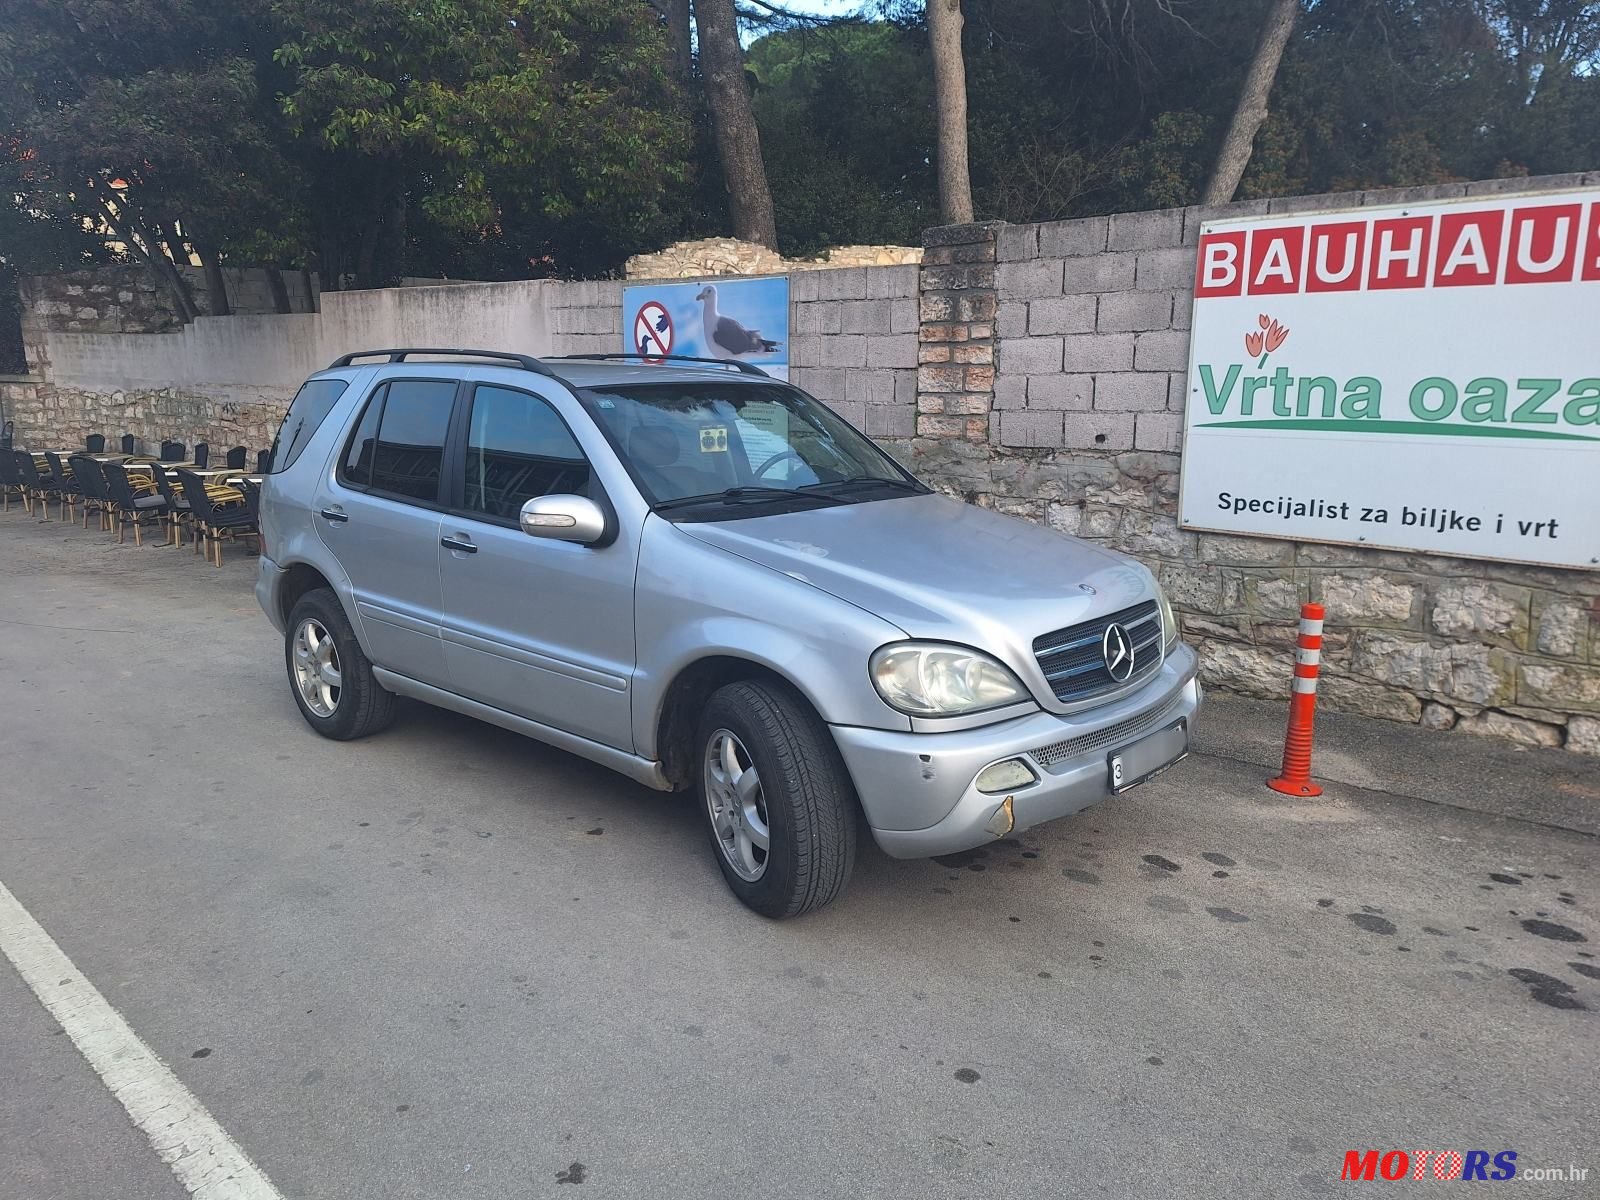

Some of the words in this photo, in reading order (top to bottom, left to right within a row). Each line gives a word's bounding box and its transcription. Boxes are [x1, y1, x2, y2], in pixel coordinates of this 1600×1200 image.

[1202, 216, 1600, 289] BAUHAU
[1199, 364, 1382, 419] Vrtna
[1408, 377, 1600, 426] oaza
[1217, 492, 1350, 520] Specijalist
[1359, 507, 1389, 523] za
[1401, 506, 1482, 533] biljke
[1495, 513, 1504, 534] i
[1517, 518, 1559, 539] vrt
